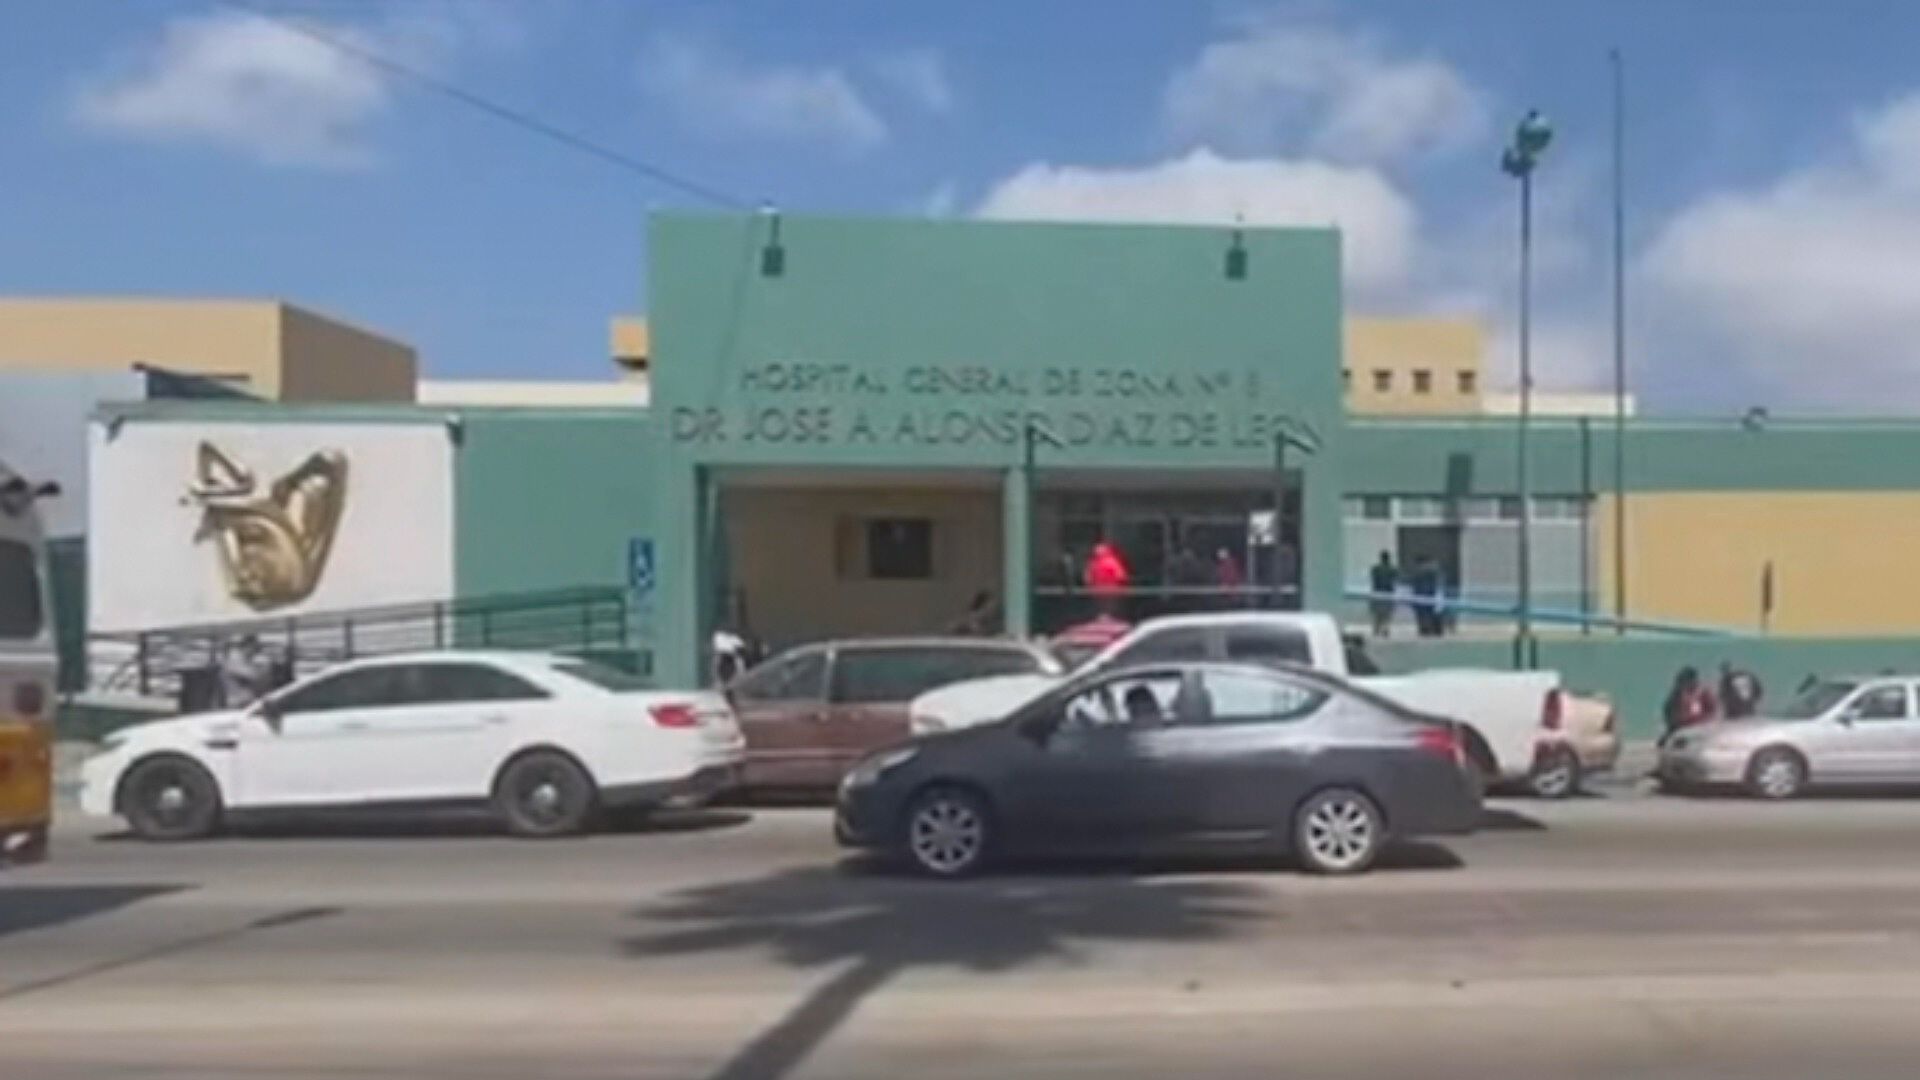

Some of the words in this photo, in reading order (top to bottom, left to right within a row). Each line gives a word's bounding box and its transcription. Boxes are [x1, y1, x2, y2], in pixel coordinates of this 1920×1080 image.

[740, 363, 888, 393] HOSPITAL
[906, 367, 1029, 396] GENERAL
[1045, 368, 1083, 396] DE
[1095, 368, 1183, 397] ZONA
[1170, 412, 1219, 446] DE
